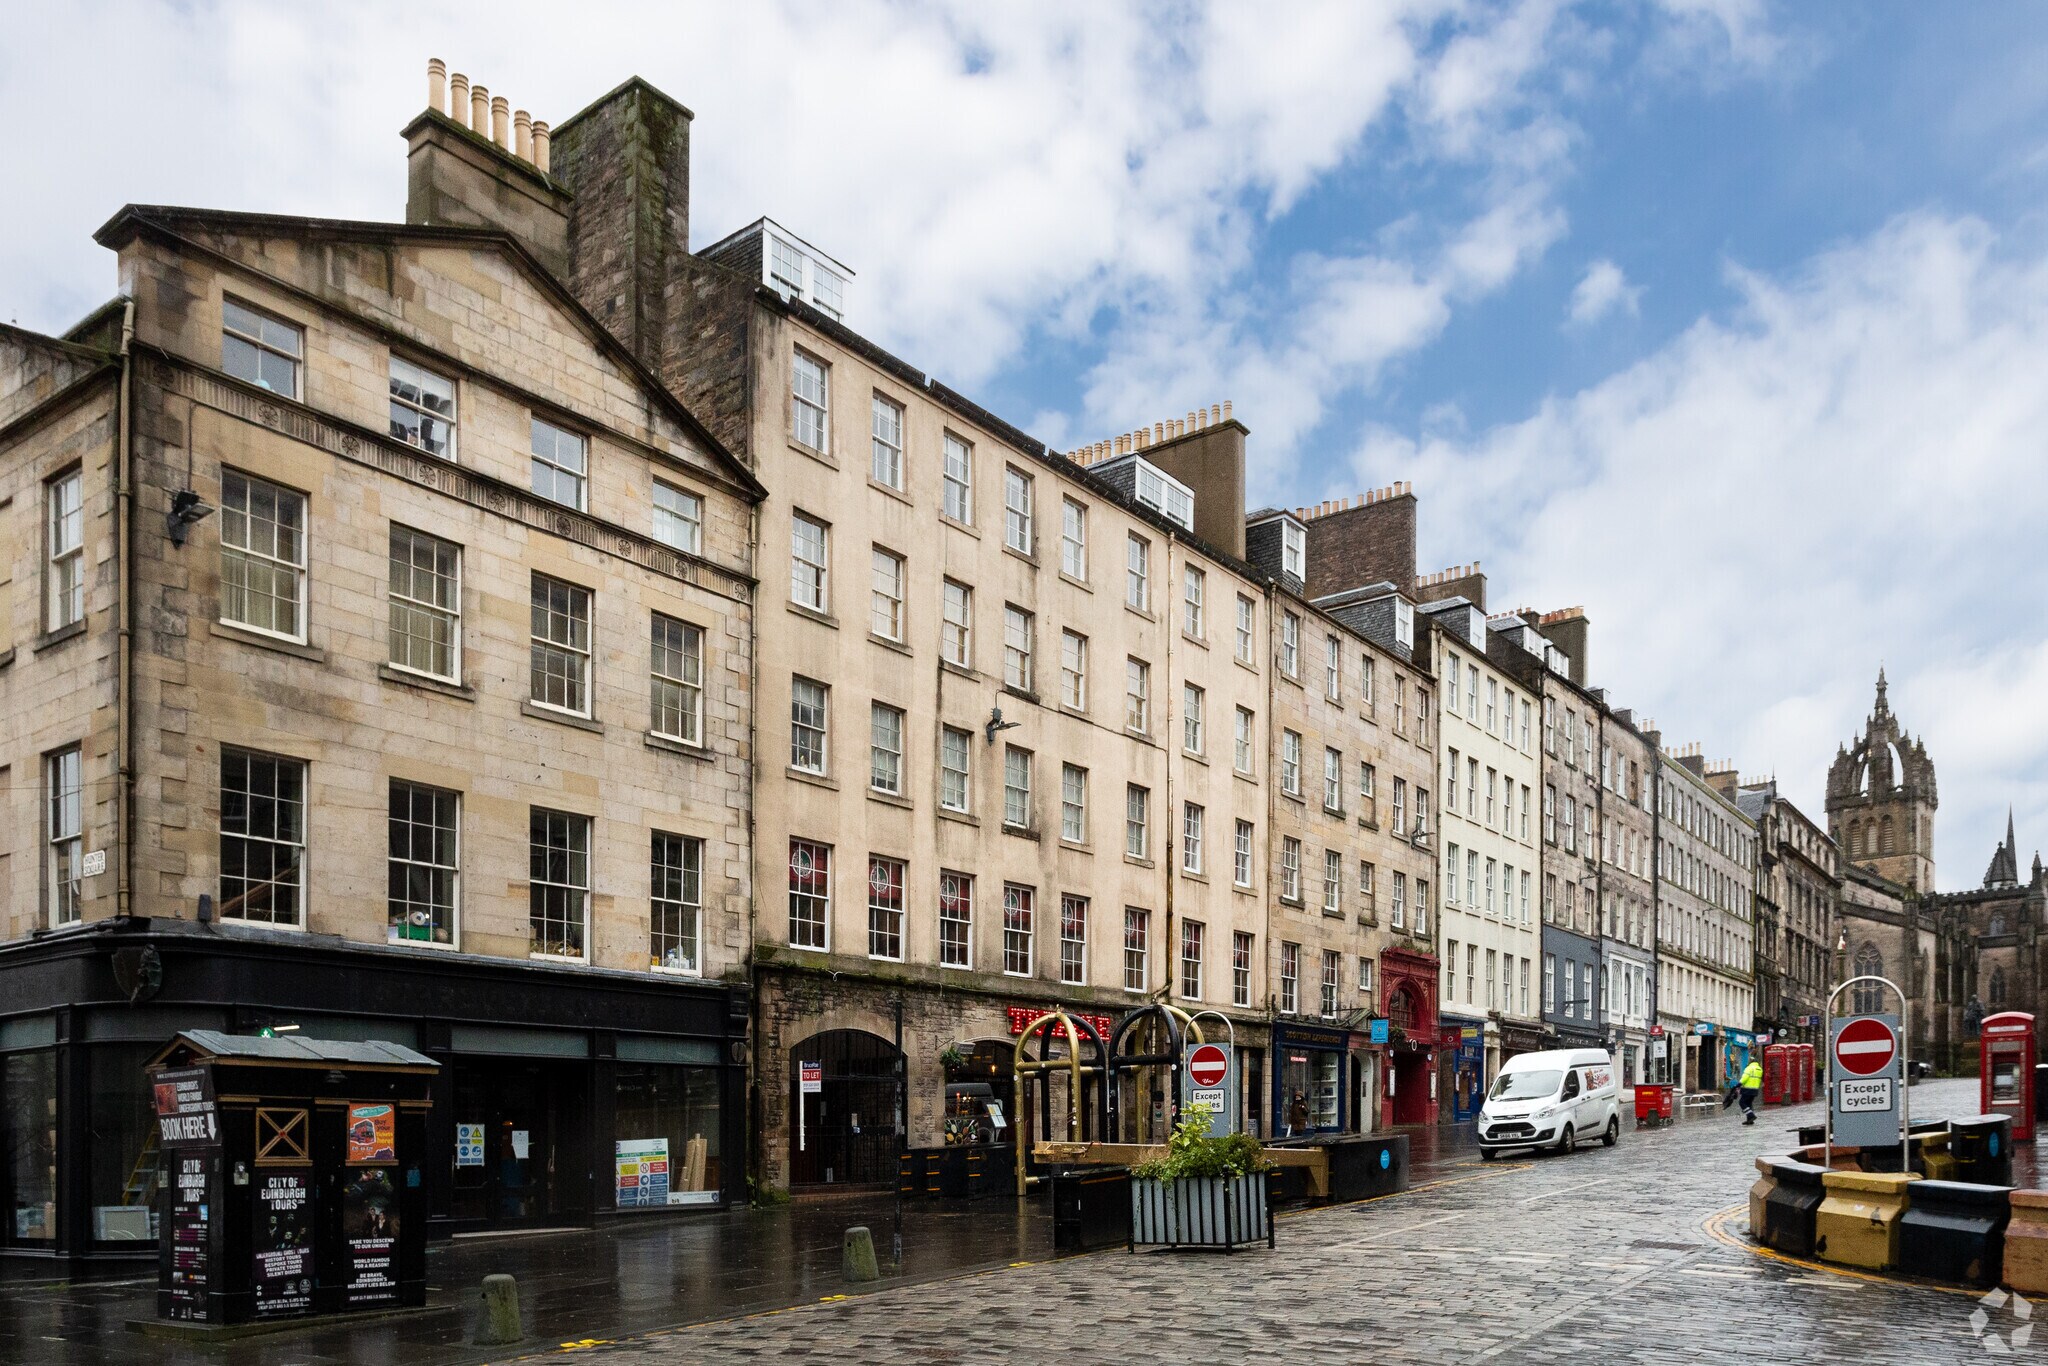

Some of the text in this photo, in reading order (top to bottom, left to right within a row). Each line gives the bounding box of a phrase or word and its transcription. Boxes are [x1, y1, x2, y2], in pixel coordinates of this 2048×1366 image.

[85, 862, 104, 875] SQUARE
[1845, 1083, 1886, 1094] Except
[1195, 1092, 1222, 1101] Except
[1846, 1095, 1885, 1107] cycles
[160, 1116, 207, 1140] BOOK HERE
[178, 1174, 205, 1188] EDINBURGH
[268, 1177, 298, 1188] CITY OF
[261, 1188, 306, 1200] EDINBURGH
[271, 1199, 297, 1210] TOURS
[264, 1260, 286, 1268] BESPOKE
